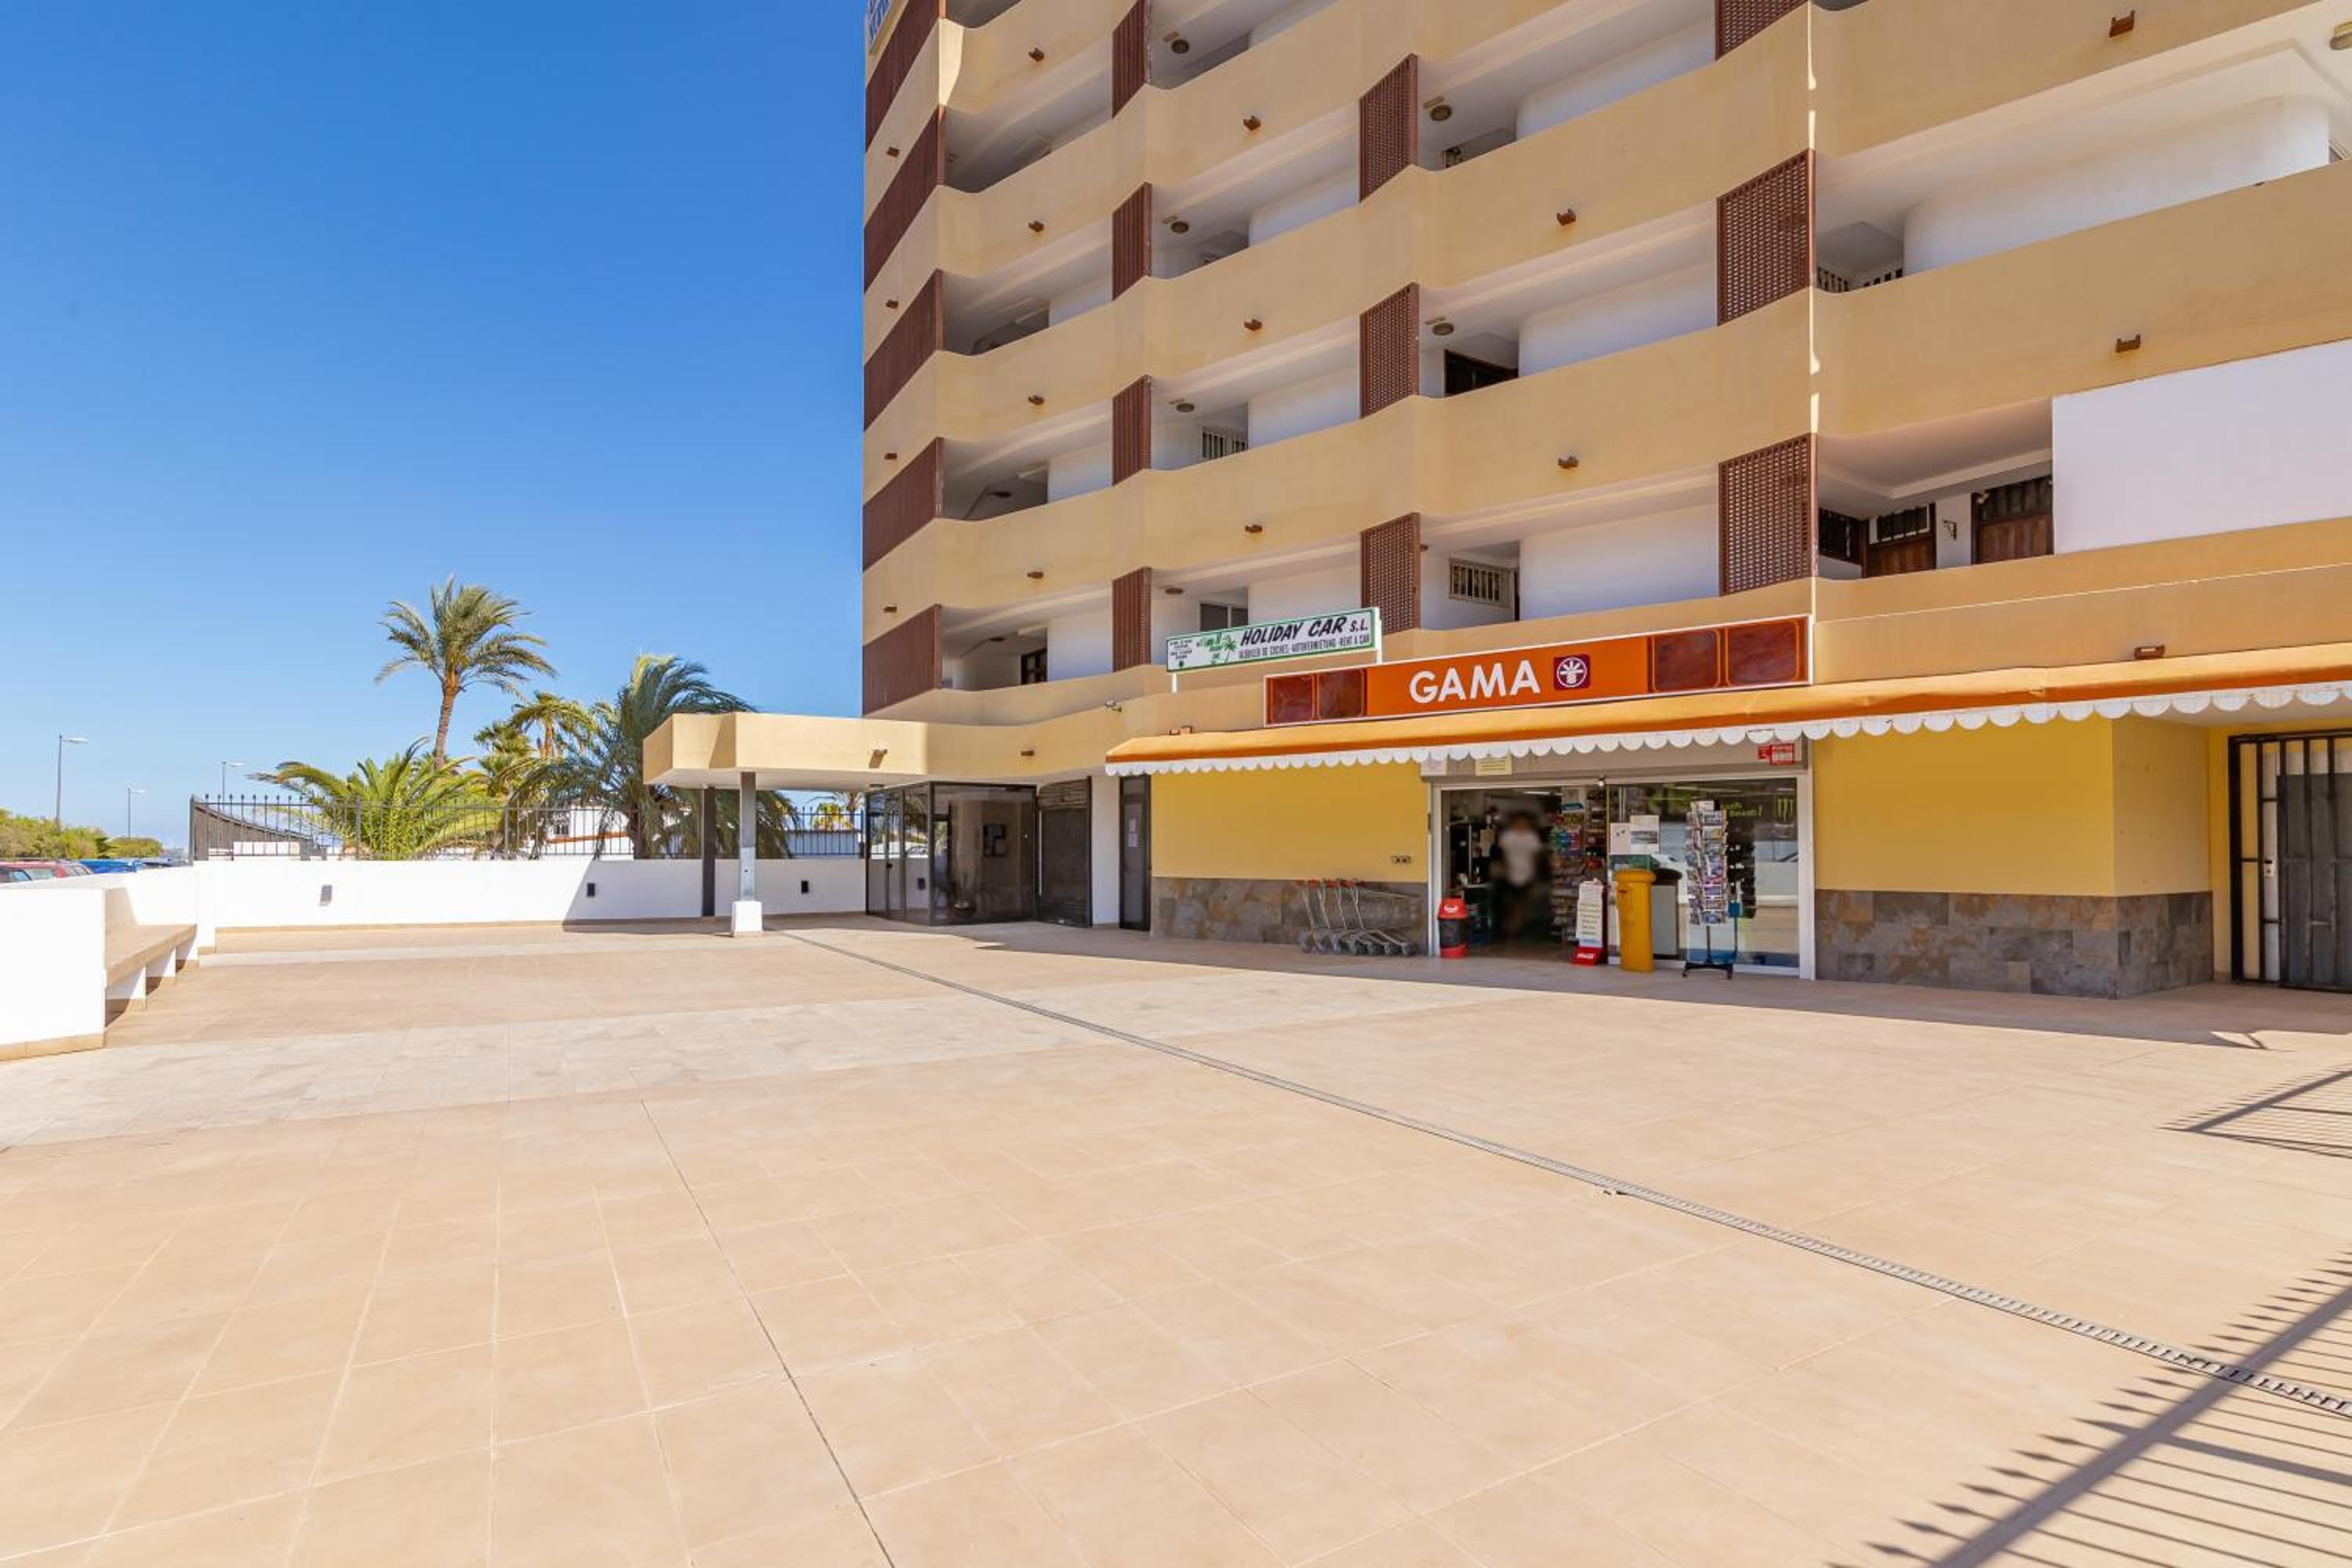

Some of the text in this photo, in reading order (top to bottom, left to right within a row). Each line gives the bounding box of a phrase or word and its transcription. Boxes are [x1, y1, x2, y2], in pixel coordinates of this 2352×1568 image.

[1240, 616, 1368, 646] HOLIDAY CAR S.L.
[1359, 633, 1370, 644] CAR
[1409, 659, 1541, 703] GAMA
